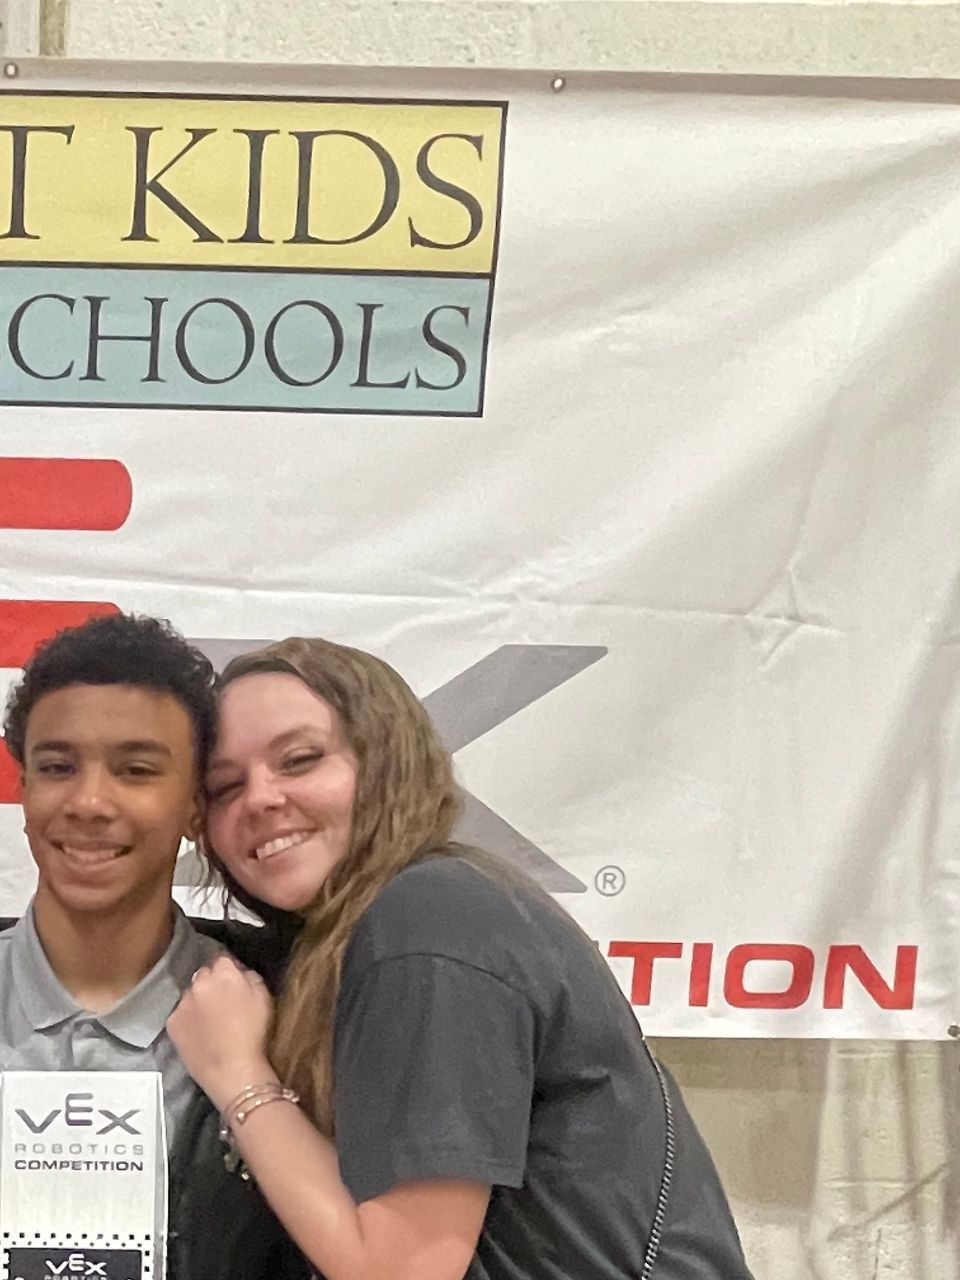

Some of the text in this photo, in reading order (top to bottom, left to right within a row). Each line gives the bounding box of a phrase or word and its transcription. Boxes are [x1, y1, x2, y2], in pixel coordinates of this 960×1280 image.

[119, 123, 485, 249] KIDS
[606, 940, 919, 1011] TION
[14, 1093, 142, 1135] VEX
[14, 1143, 144, 1155] ROBOTICS
[14, 1160, 144, 1171] COMPETITION
[45, 1253, 107, 1275] VEX
